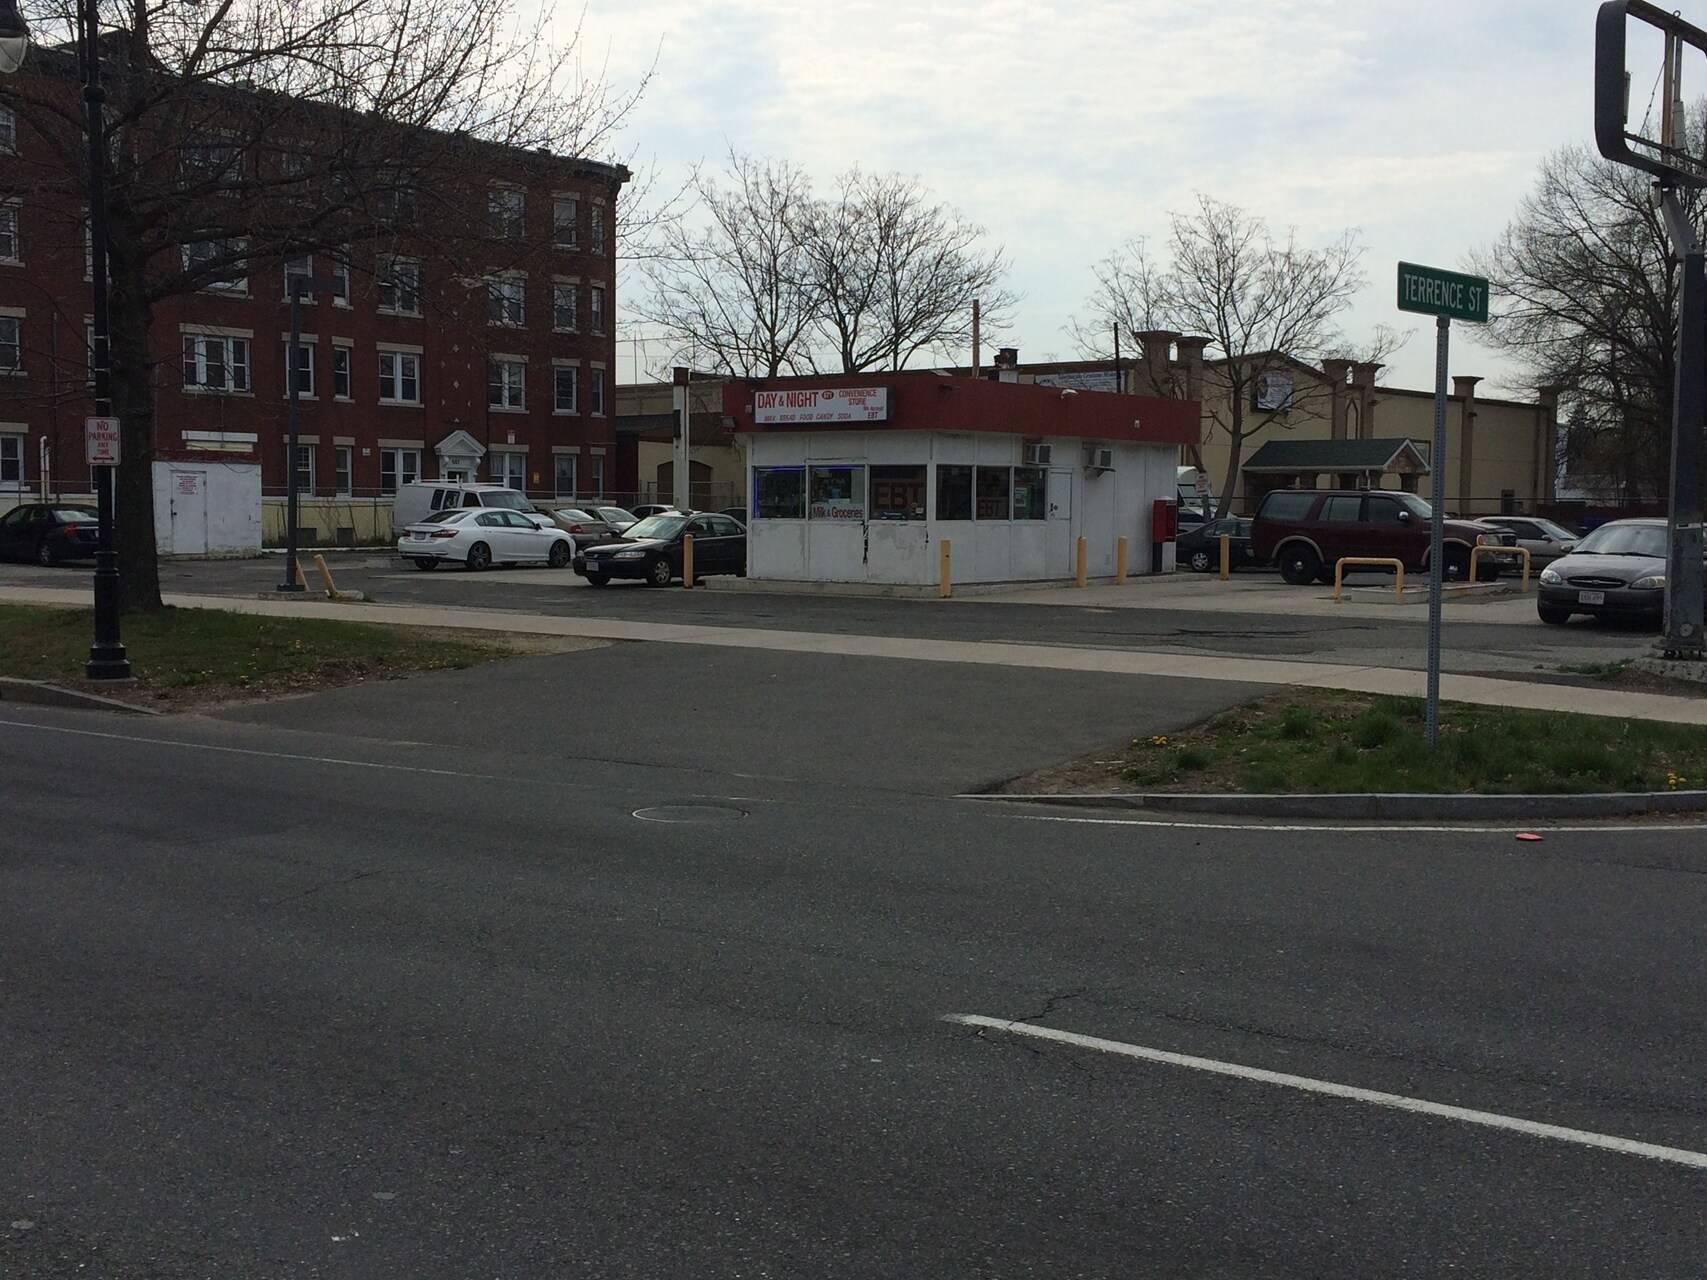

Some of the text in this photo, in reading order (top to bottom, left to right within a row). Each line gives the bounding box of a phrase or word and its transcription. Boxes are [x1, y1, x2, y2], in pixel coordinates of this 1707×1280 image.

[1404, 274, 1482, 312] TERRENCE ST
[838, 389, 877, 398] CONVENIENCE
[758, 393, 778, 409] DAY
[779, 395, 785, 407] &
[786, 392, 819, 408] NIGHT
[848, 398, 866, 406] STORE
[799, 413, 813, 421] FOOD
[816, 412, 834, 420] CANDY
[837, 412, 852, 420] SODA
[867, 411, 879, 419] EBT
[97, 421, 109, 431] NO
[88, 432, 118, 441] PARKING
[873, 482, 925, 509] EBT
[813, 506, 826, 518] Milk
[831, 506, 863, 518] Groceries
[978, 499, 1002, 517] EBT
